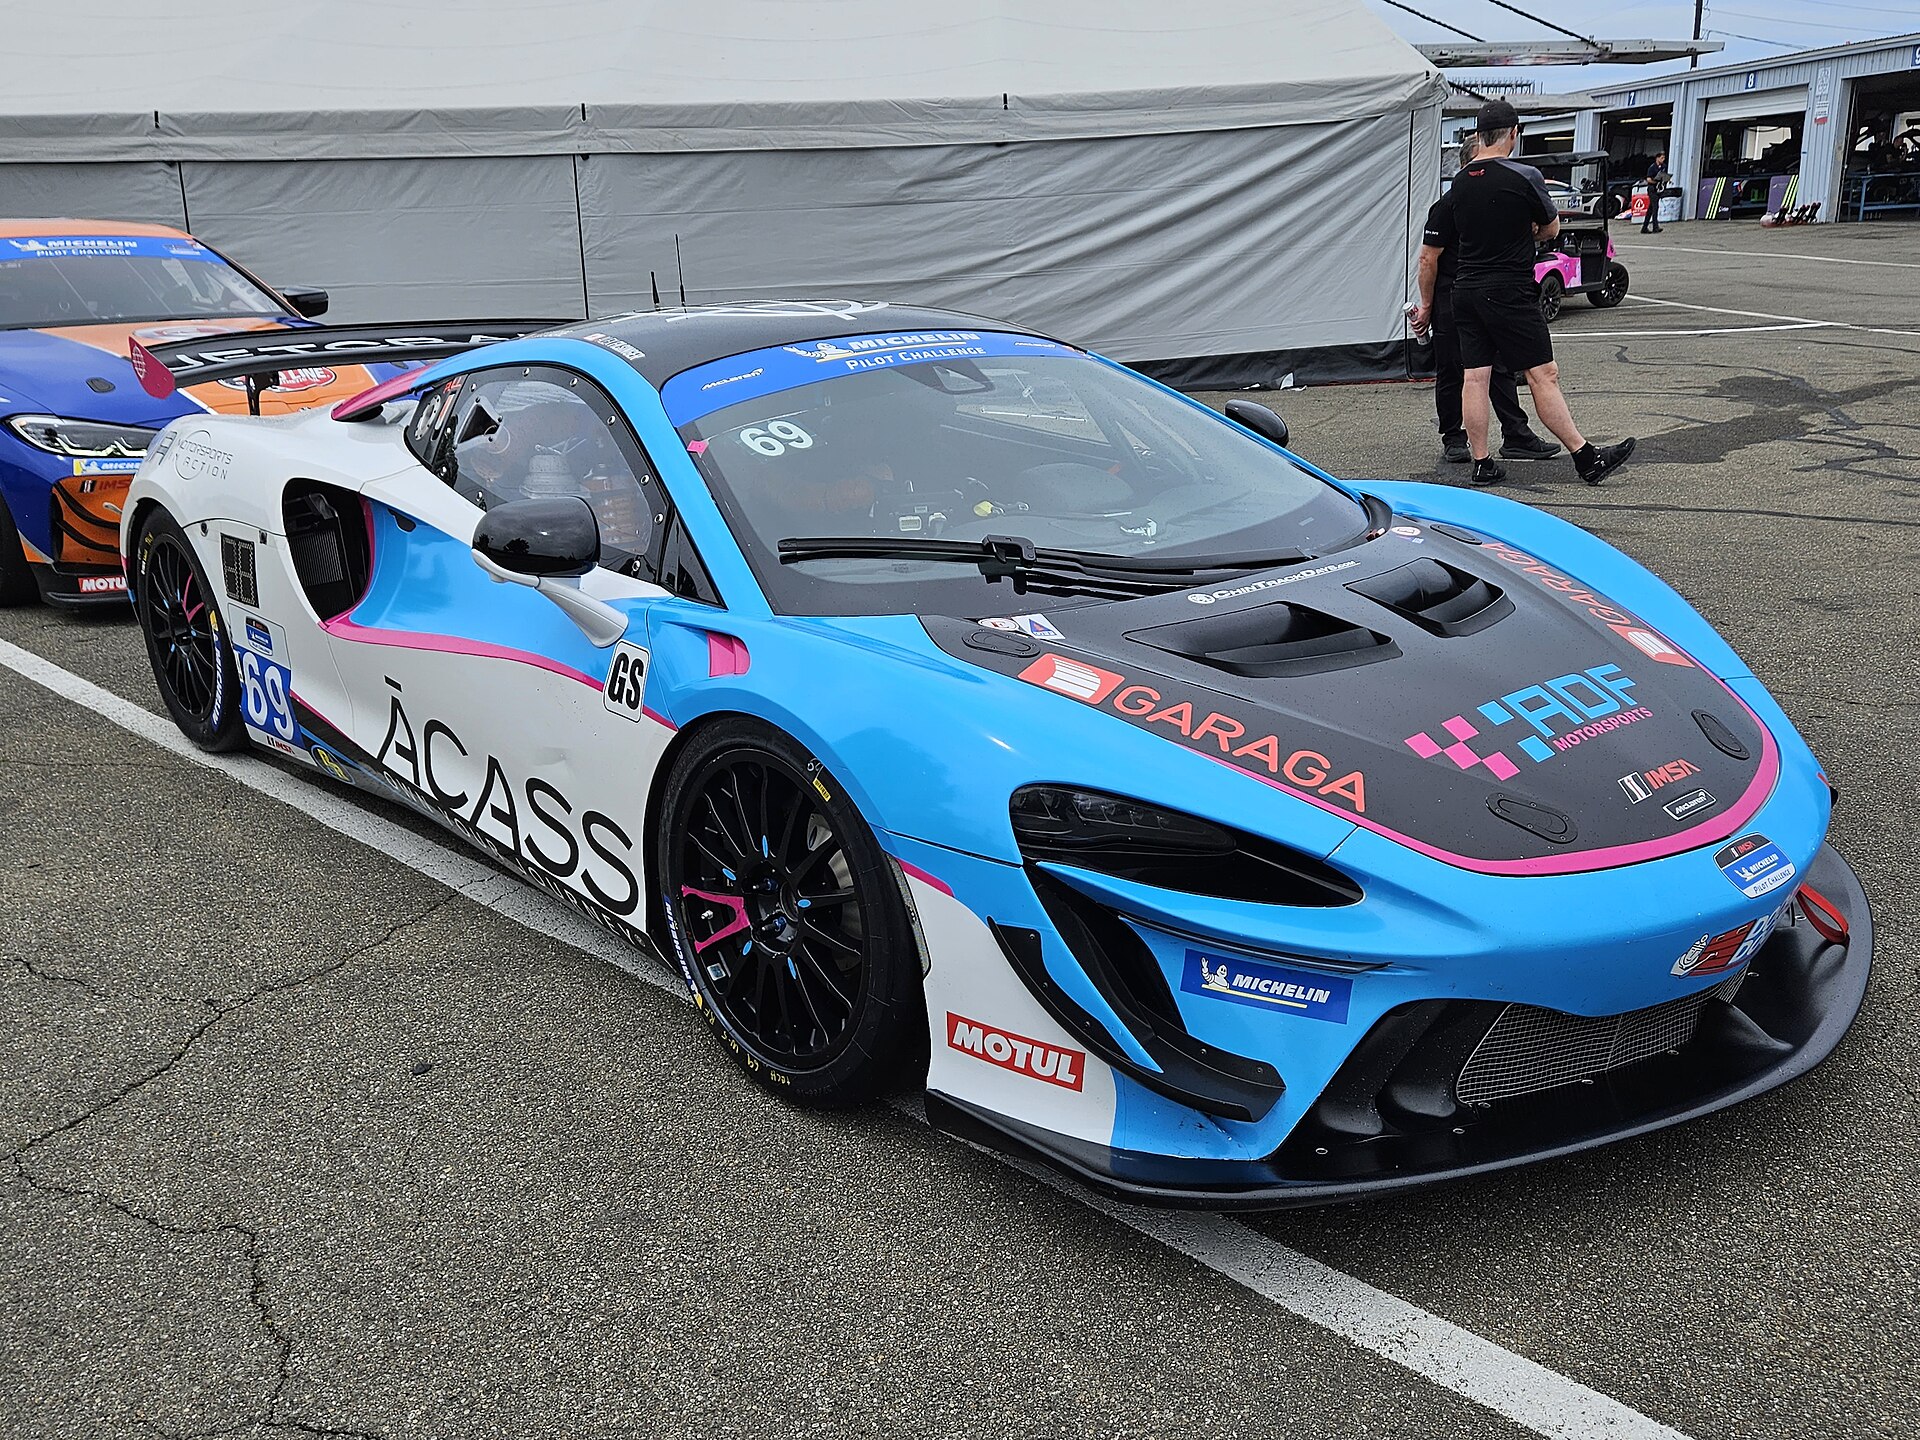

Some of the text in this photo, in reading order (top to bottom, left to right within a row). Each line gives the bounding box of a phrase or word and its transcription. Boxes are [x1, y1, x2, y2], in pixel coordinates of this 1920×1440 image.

[1747, 73, 1754, 88] 8
[1629, 92, 1635, 104] 7
[47, 240, 138, 248] MICHELIN
[71, 248, 132, 256] CHALLENGE
[169, 334, 525, 372] JETCRA
[848, 332, 981, 350] MICHELIN
[845, 346, 987, 371] PILOT CHALLENGE
[701, 367, 764, 391] McLaren
[740, 420, 813, 456] 69
[179, 439, 234, 465] MOTORSPORTS
[101, 461, 141, 471] MICHE
[183, 456, 228, 480] ACTION
[99, 479, 131, 491] IMS
[80, 577, 128, 592] MOTU
[1481, 542, 1632, 626] GARAGA
[607, 652, 644, 711] GS
[242, 651, 294, 741] 69
[1501, 663, 1638, 738] ADF
[1552, 706, 1654, 752] MOTORSPORTS
[1112, 685, 1366, 813] GARAGA
[1643, 758, 1702, 790] IMSA
[1675, 791, 1708, 814] McLaren
[1748, 853, 1779, 873] MICHELIN
[1753, 869, 1792, 895] PILOT CHALLENGE
[665, 901, 692, 981] MICHELIN
[1232, 973, 1331, 1004] MICHELIN
[952, 1021, 1077, 1084] MOTUL
